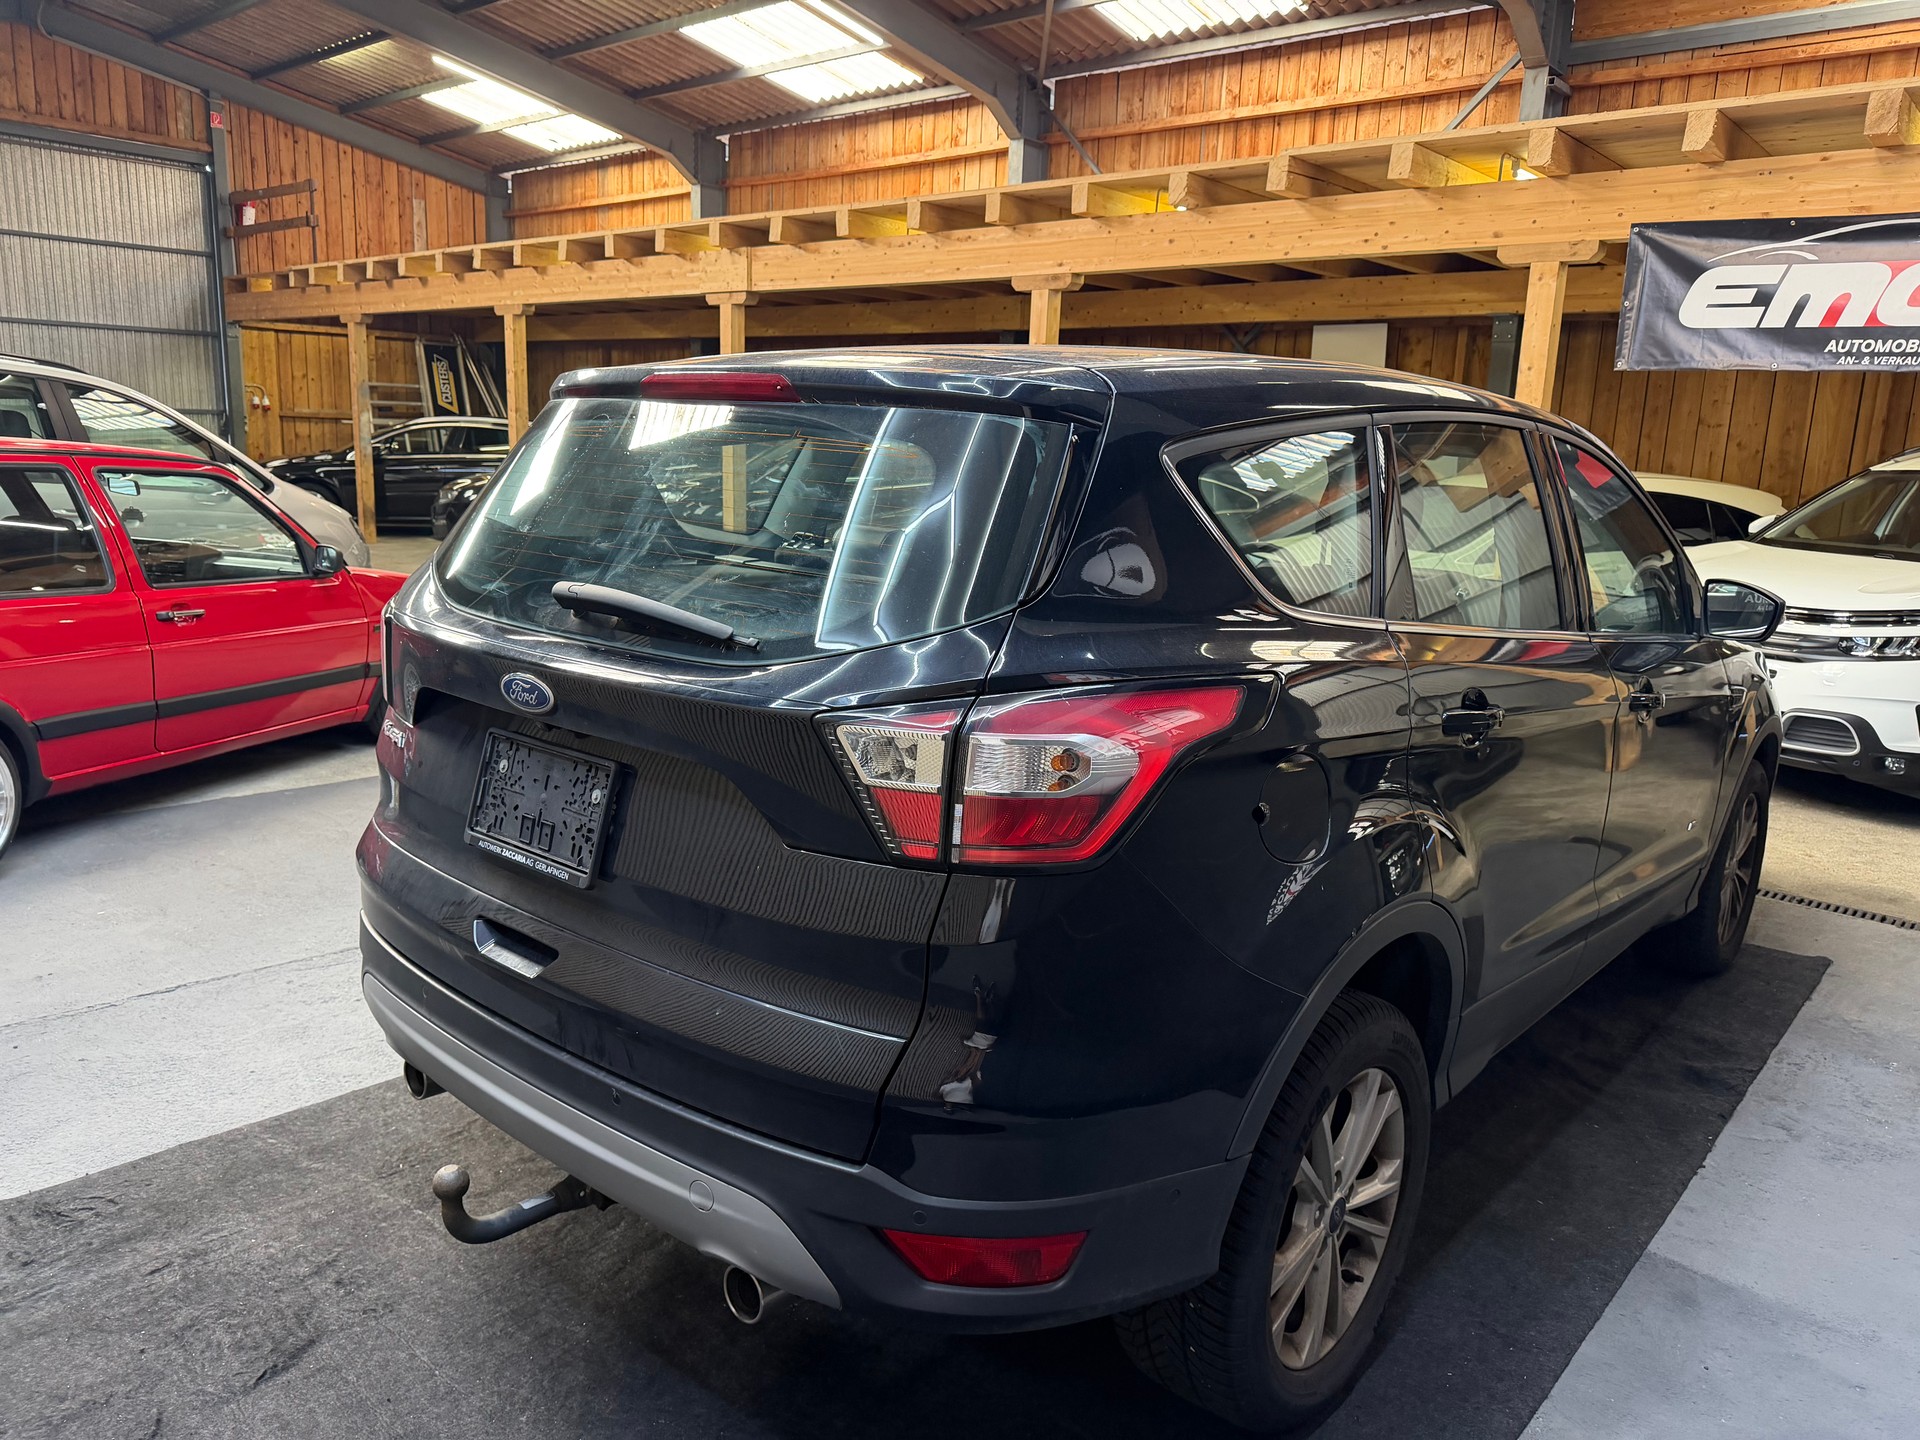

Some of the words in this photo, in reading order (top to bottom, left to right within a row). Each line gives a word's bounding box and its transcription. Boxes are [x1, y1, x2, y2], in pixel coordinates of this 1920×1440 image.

[1823, 338, 1920, 353] AUTOMOB
[1836, 355, 1860, 365] AN-
[1861, 355, 1871, 365] &
[1873, 355, 1920, 366] VERKAU
[437, 360, 452, 403] CUSTERS
[509, 680, 538, 705] Ford
[478, 840, 502, 855] AUTOWERK
[501, 848, 526, 864] ZACCARIA
[525, 858, 535, 867] AG
[534, 861, 570, 881] GERLAFINGEN
